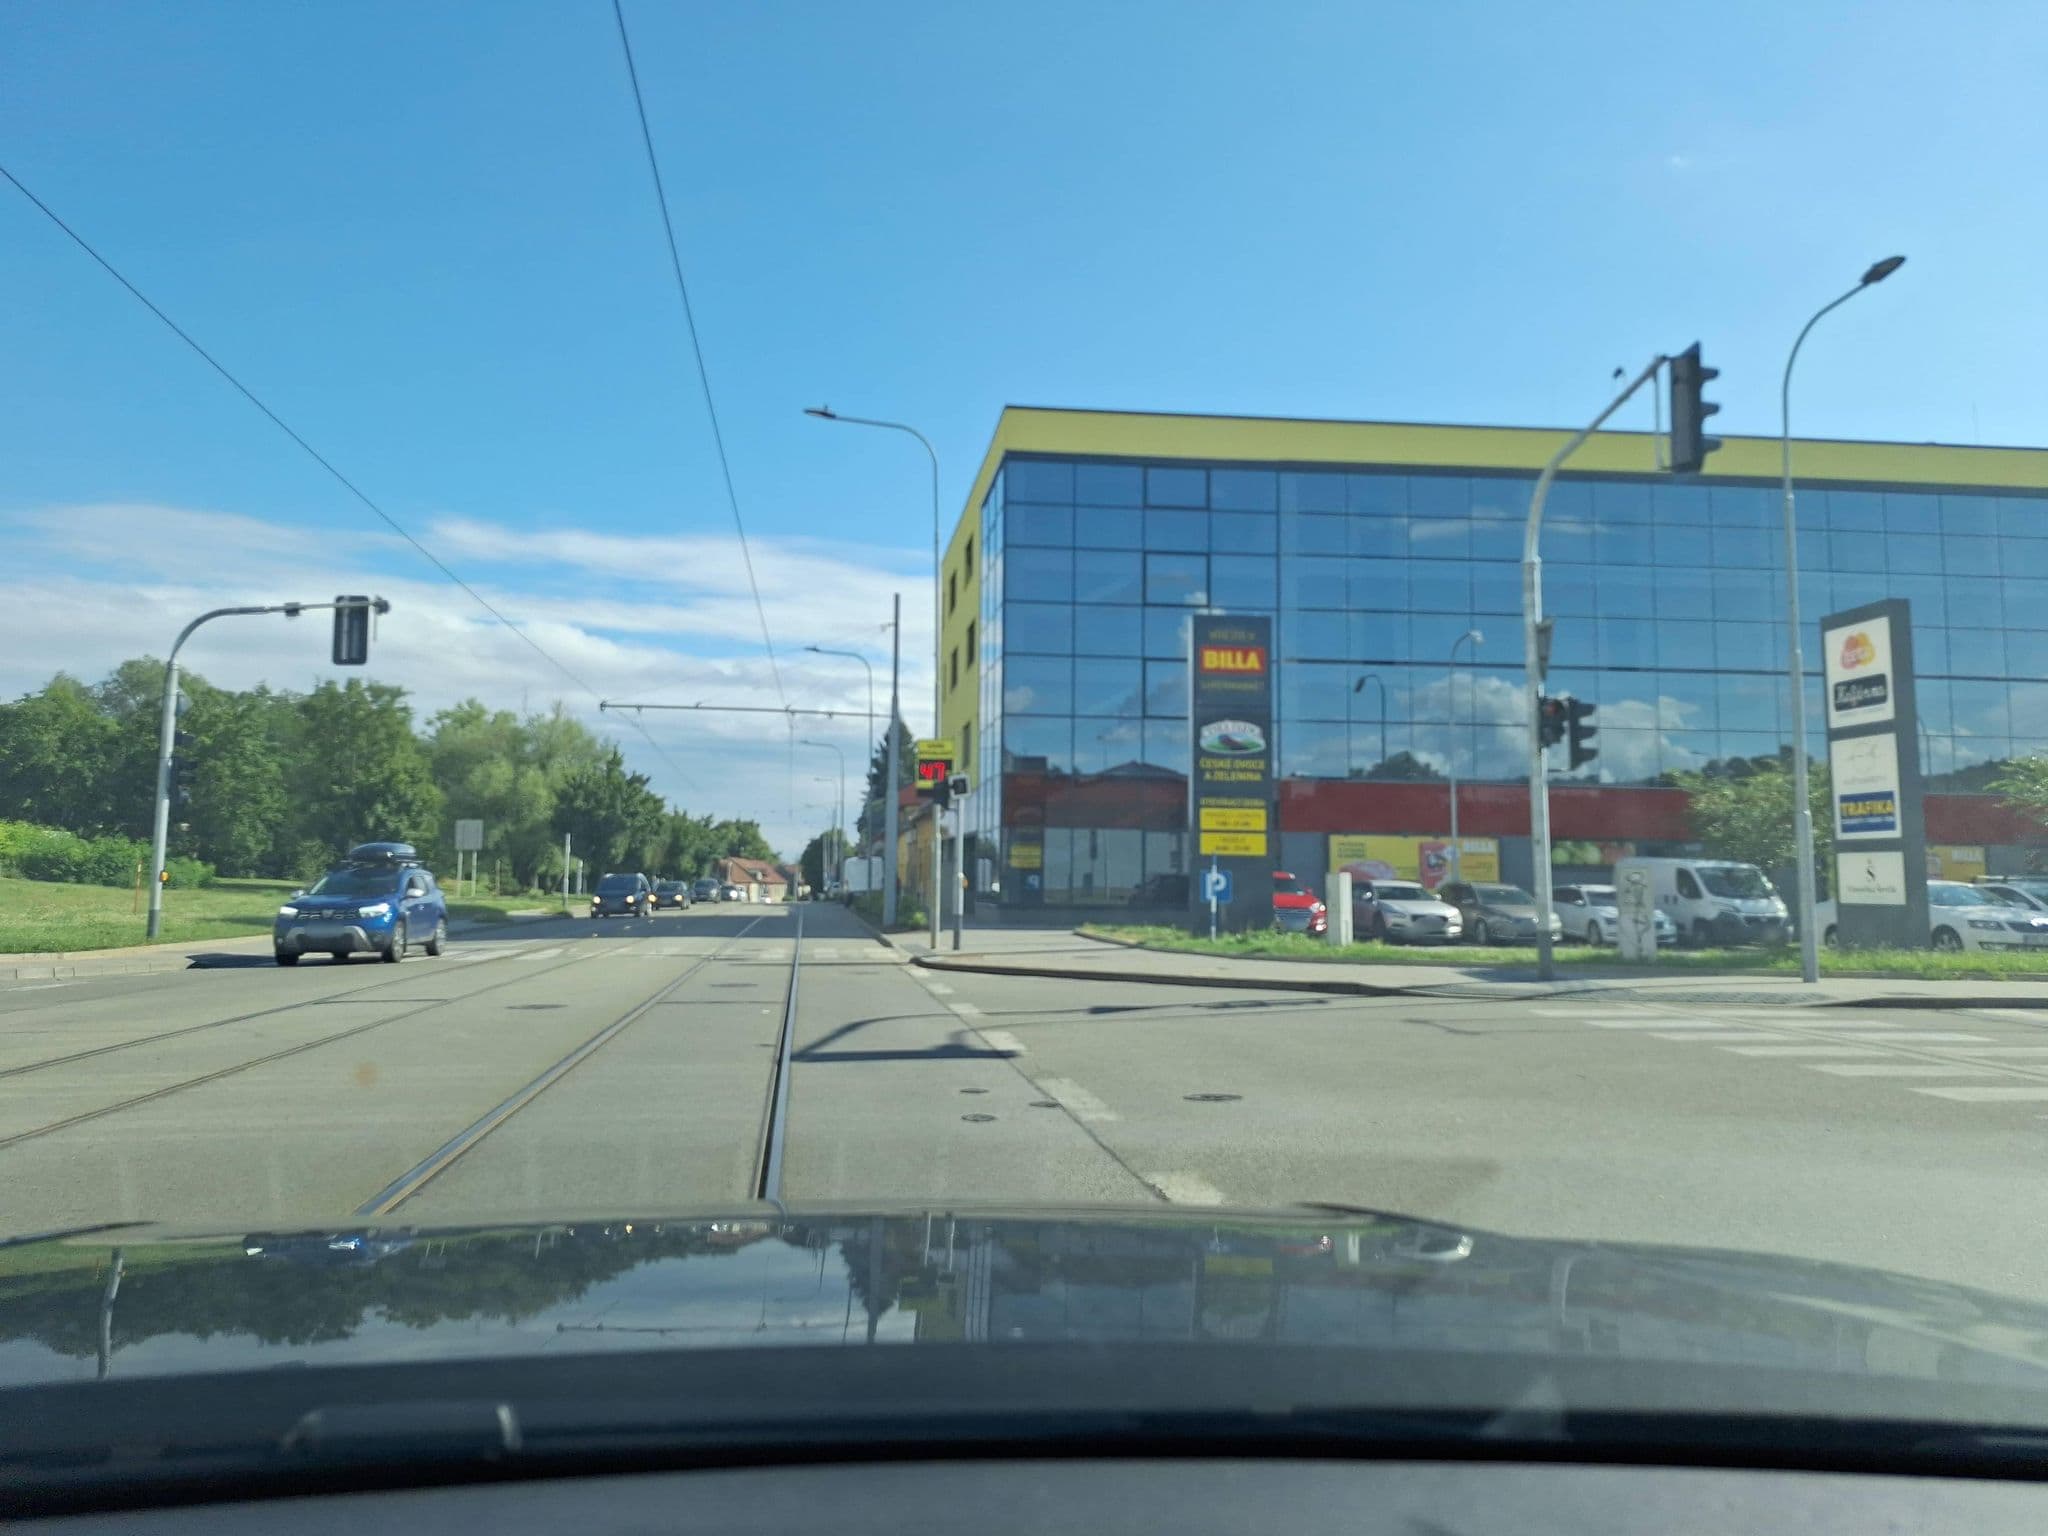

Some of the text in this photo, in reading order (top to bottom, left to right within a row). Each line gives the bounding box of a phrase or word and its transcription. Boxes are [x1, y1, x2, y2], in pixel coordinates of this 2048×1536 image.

[1203, 649, 1261, 669] BILLA
[920, 761, 945, 783] 47
[1840, 801, 1894, 817] TRAFIKA
